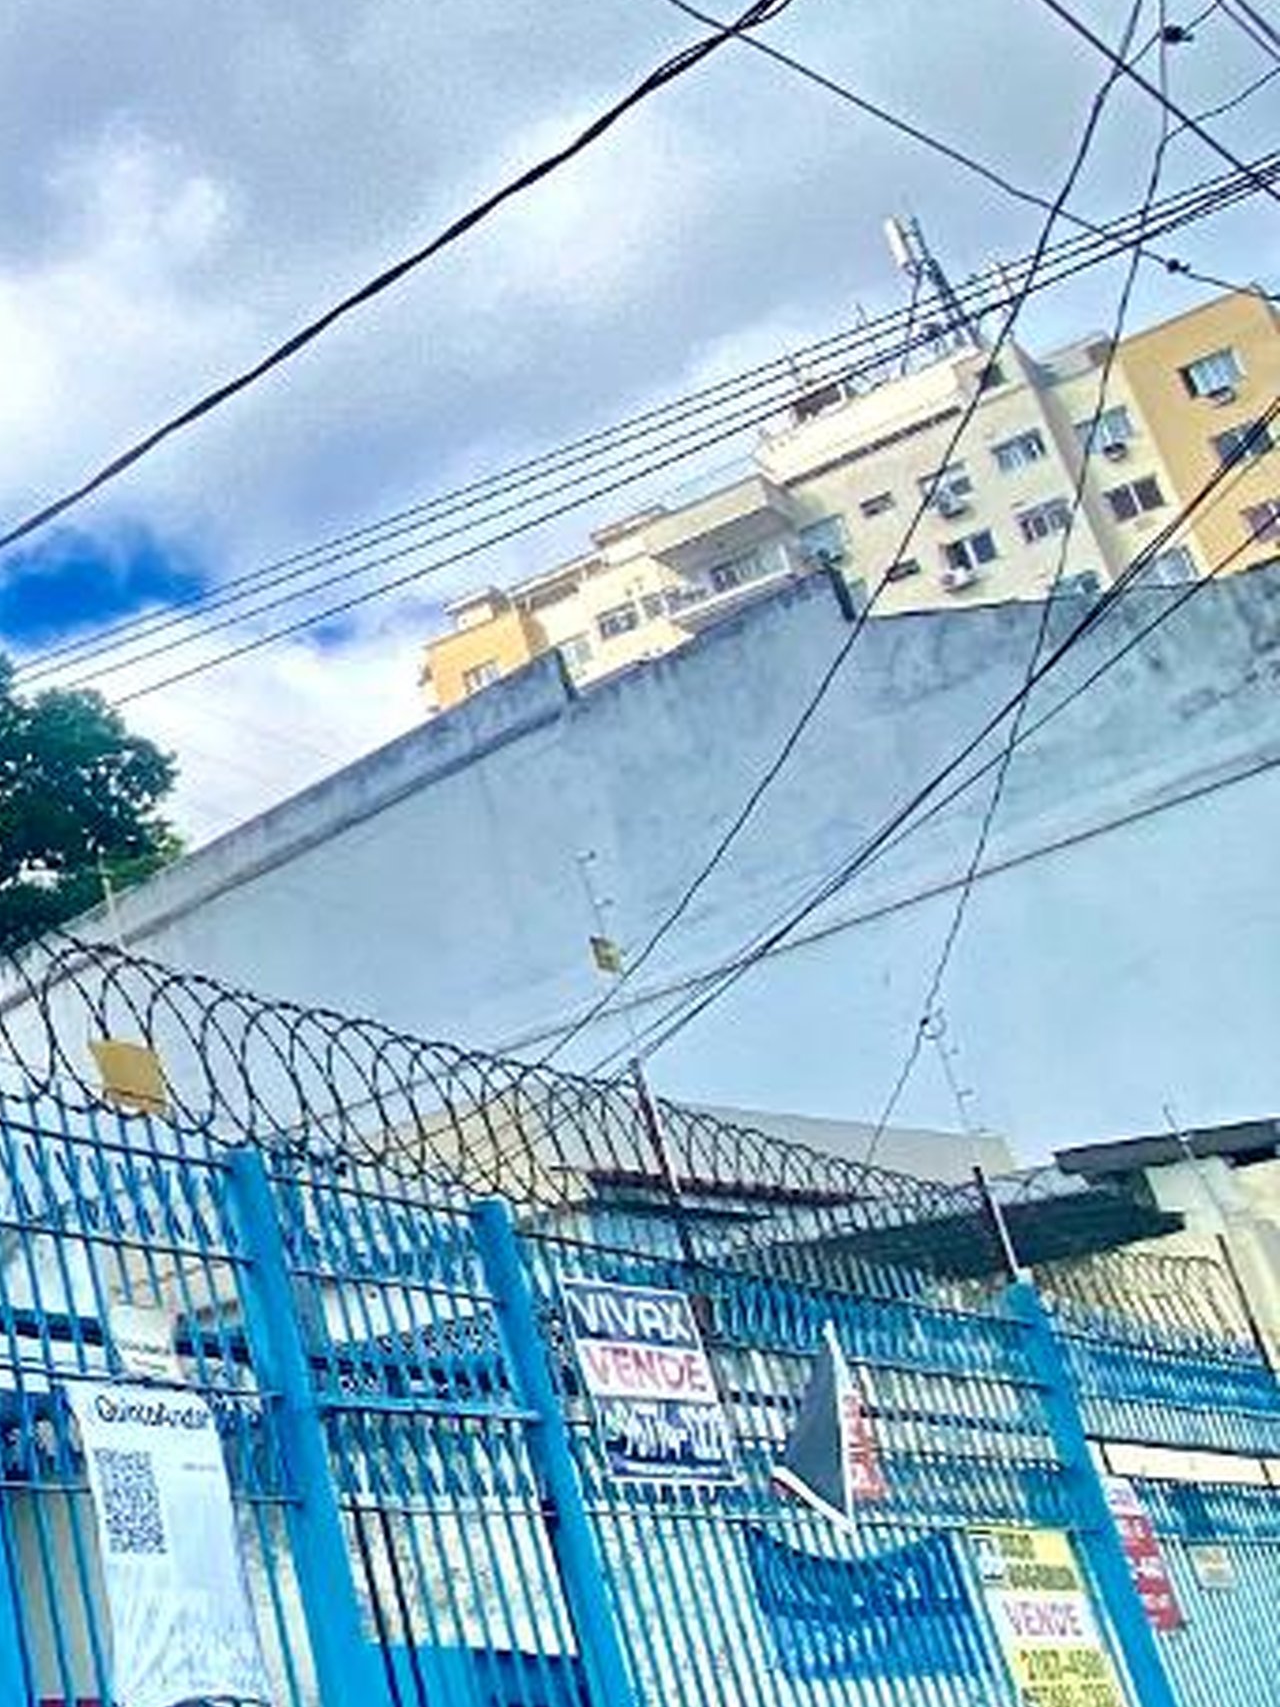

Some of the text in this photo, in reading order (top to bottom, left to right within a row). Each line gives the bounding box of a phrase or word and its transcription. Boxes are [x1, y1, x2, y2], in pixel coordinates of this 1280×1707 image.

[564, 1290, 693, 1341] VIVAX
[587, 1345, 708, 1393] VENDE
[1002, 1600, 1083, 1637] VENDE
